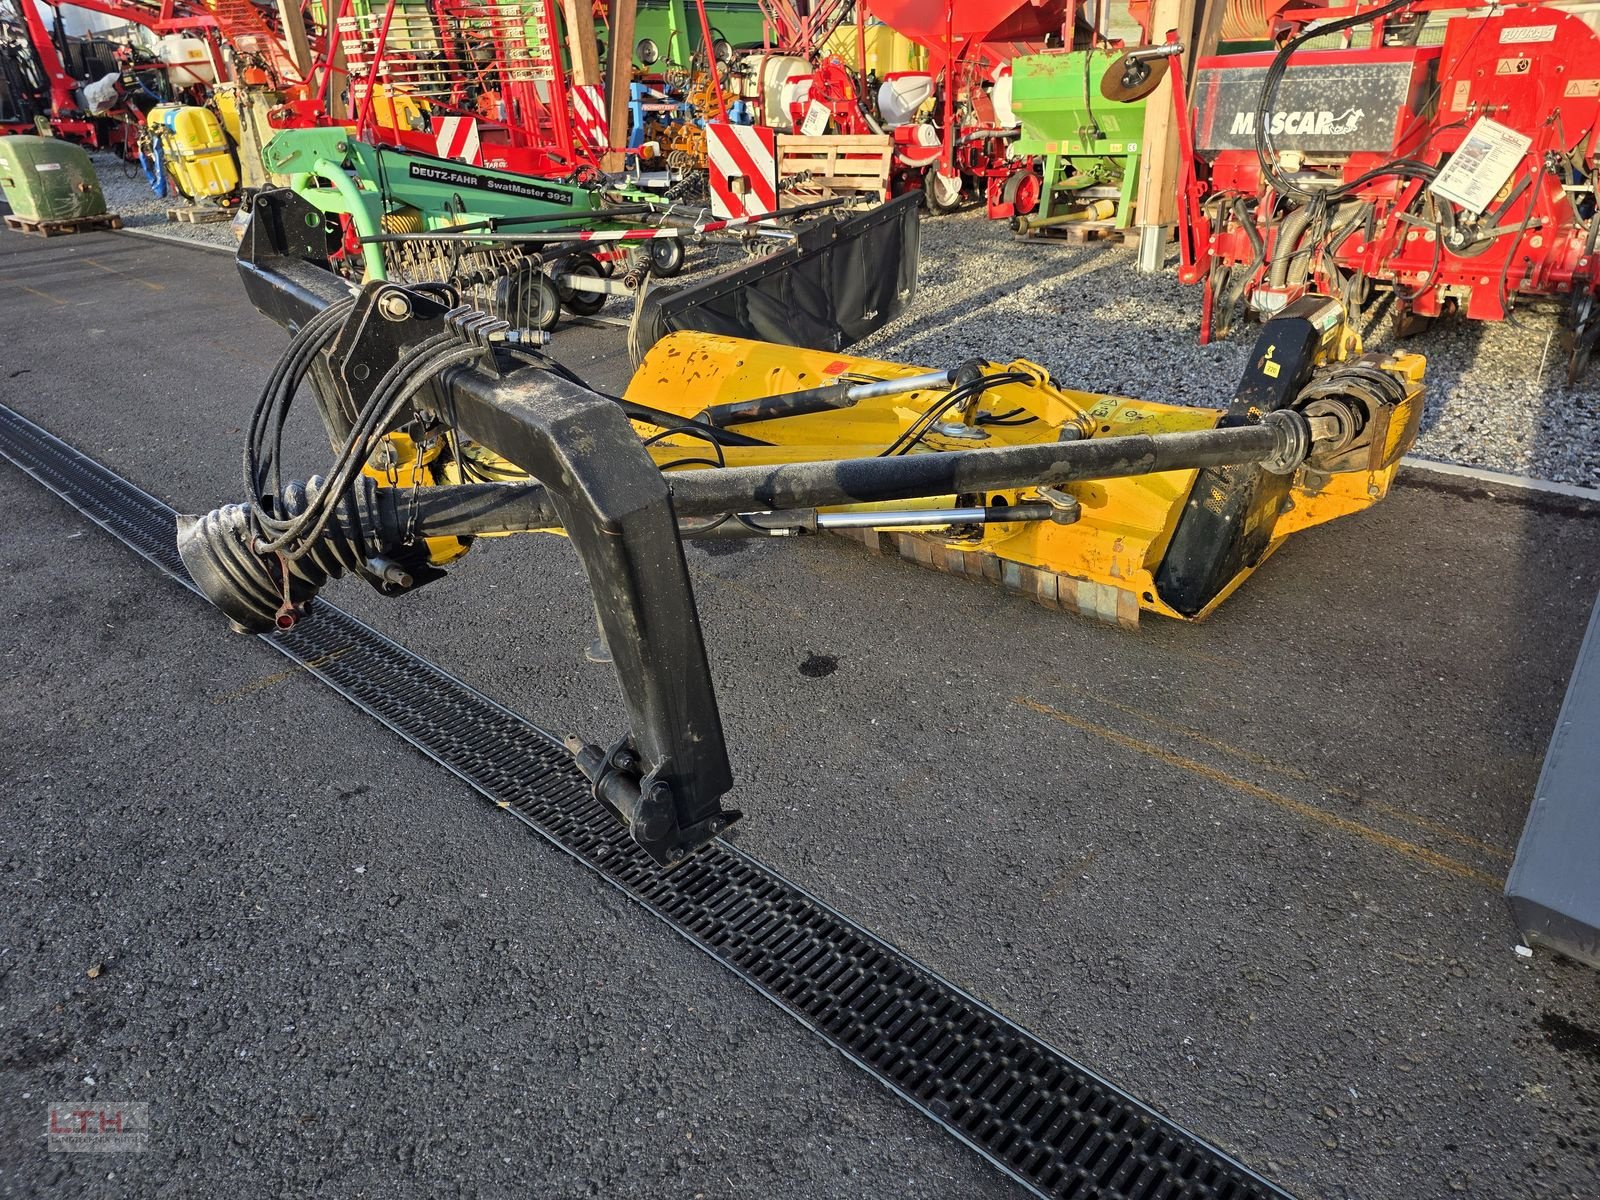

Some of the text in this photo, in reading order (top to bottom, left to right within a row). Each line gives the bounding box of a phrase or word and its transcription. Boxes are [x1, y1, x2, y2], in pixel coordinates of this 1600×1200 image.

[412, 166, 572, 203] DEUTZ-FAHR SwatMaster 3921
